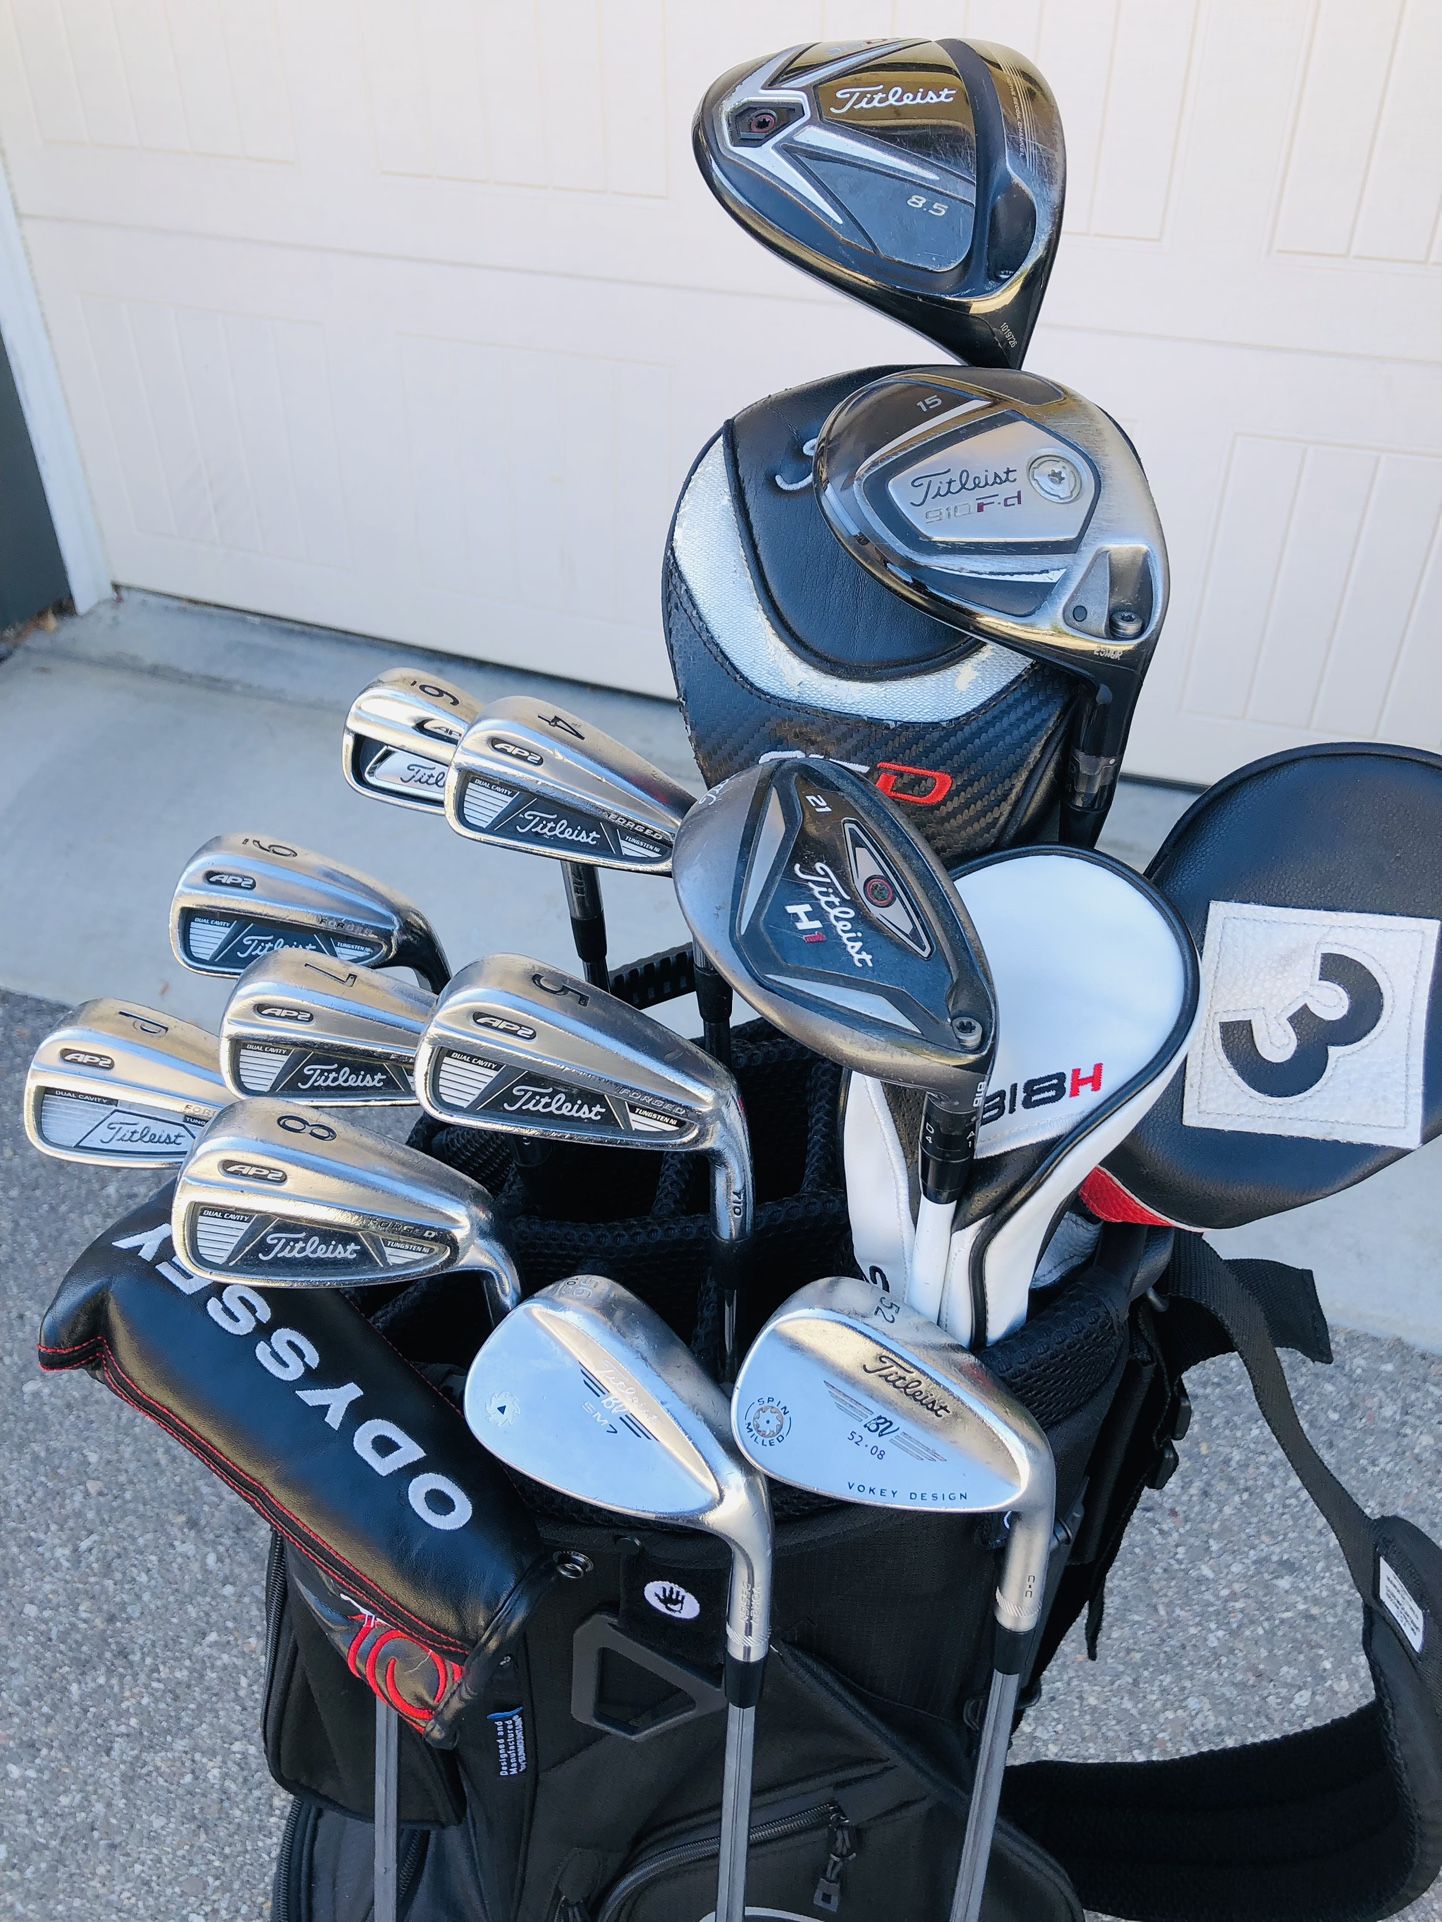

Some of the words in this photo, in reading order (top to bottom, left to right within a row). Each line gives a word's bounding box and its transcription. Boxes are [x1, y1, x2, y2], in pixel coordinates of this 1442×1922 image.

[829, 84, 957, 114] Titleist
[1017, 121, 1025, 157] CHANNEL
[907, 194, 949, 217] 8.5
[916, 394, 942, 412] 15
[910, 467, 1018, 507] Titleist
[537, 714, 586, 741] 4
[494, 743, 542, 764] AP2
[400, 763, 447, 788] Titl
[474, 778, 490, 789] DUAL
[491, 783, 512, 796] CAVITY
[805, 794, 832, 813] 21
[516, 811, 600, 845] Titleist
[625, 835, 654, 851] TUNGSTEN
[209, 873, 254, 888] AP2
[194, 917, 210, 925] DUAL
[210, 919, 231, 928] CAVITY
[784, 903, 827, 944] H1
[793, 862, 873, 968] Titleist
[303, 962, 358, 988] 7
[531, 973, 590, 1007] 5
[118, 1010, 168, 1038] P
[261, 1008, 311, 1021] AP2
[1219, 952, 1384, 1098] 3
[476, 1017, 535, 1039] AP2
[65, 1052, 112, 1067] AP2
[246, 1043, 264, 1052] DUAL
[265, 1045, 287, 1055] CAVITY
[451, 1052, 471, 1063] DUAL
[472, 1056, 498, 1070] CAVITY
[297, 1063, 387, 1090] Titleist
[55, 1089, 77, 1099] DUAL
[78, 1092, 108, 1104] CAVITY
[503, 1085, 606, 1121] Titleist
[619, 1089, 687, 1115] FORGED
[186, 1117, 206, 1126] TUNG
[634, 1107, 669, 1124] TUNGSTEN
[99, 1122, 184, 1146] Titleist
[276, 1114, 338, 1142] 8
[226, 1164, 284, 1181] AP2
[203, 1209, 223, 1219] DUAL
[224, 1213, 250, 1222] CAVITY
[258, 1231, 361, 1261] Titleist
[386, 1240, 420, 1252] TUNGSTEN
[874, 1297, 900, 1324] 52
[863, 1354, 951, 1418] Titleist
[757, 1397, 789, 1416] SPIN
[745, 1422, 785, 1447] MILLED
[847, 1481, 898, 1499] VOKEY
[909, 1491, 968, 1502] DESIGN
[495, 1721, 504, 1736] and
[497, 1739, 508, 1775] Designed
[506, 1720, 517, 1774] Manufactured
